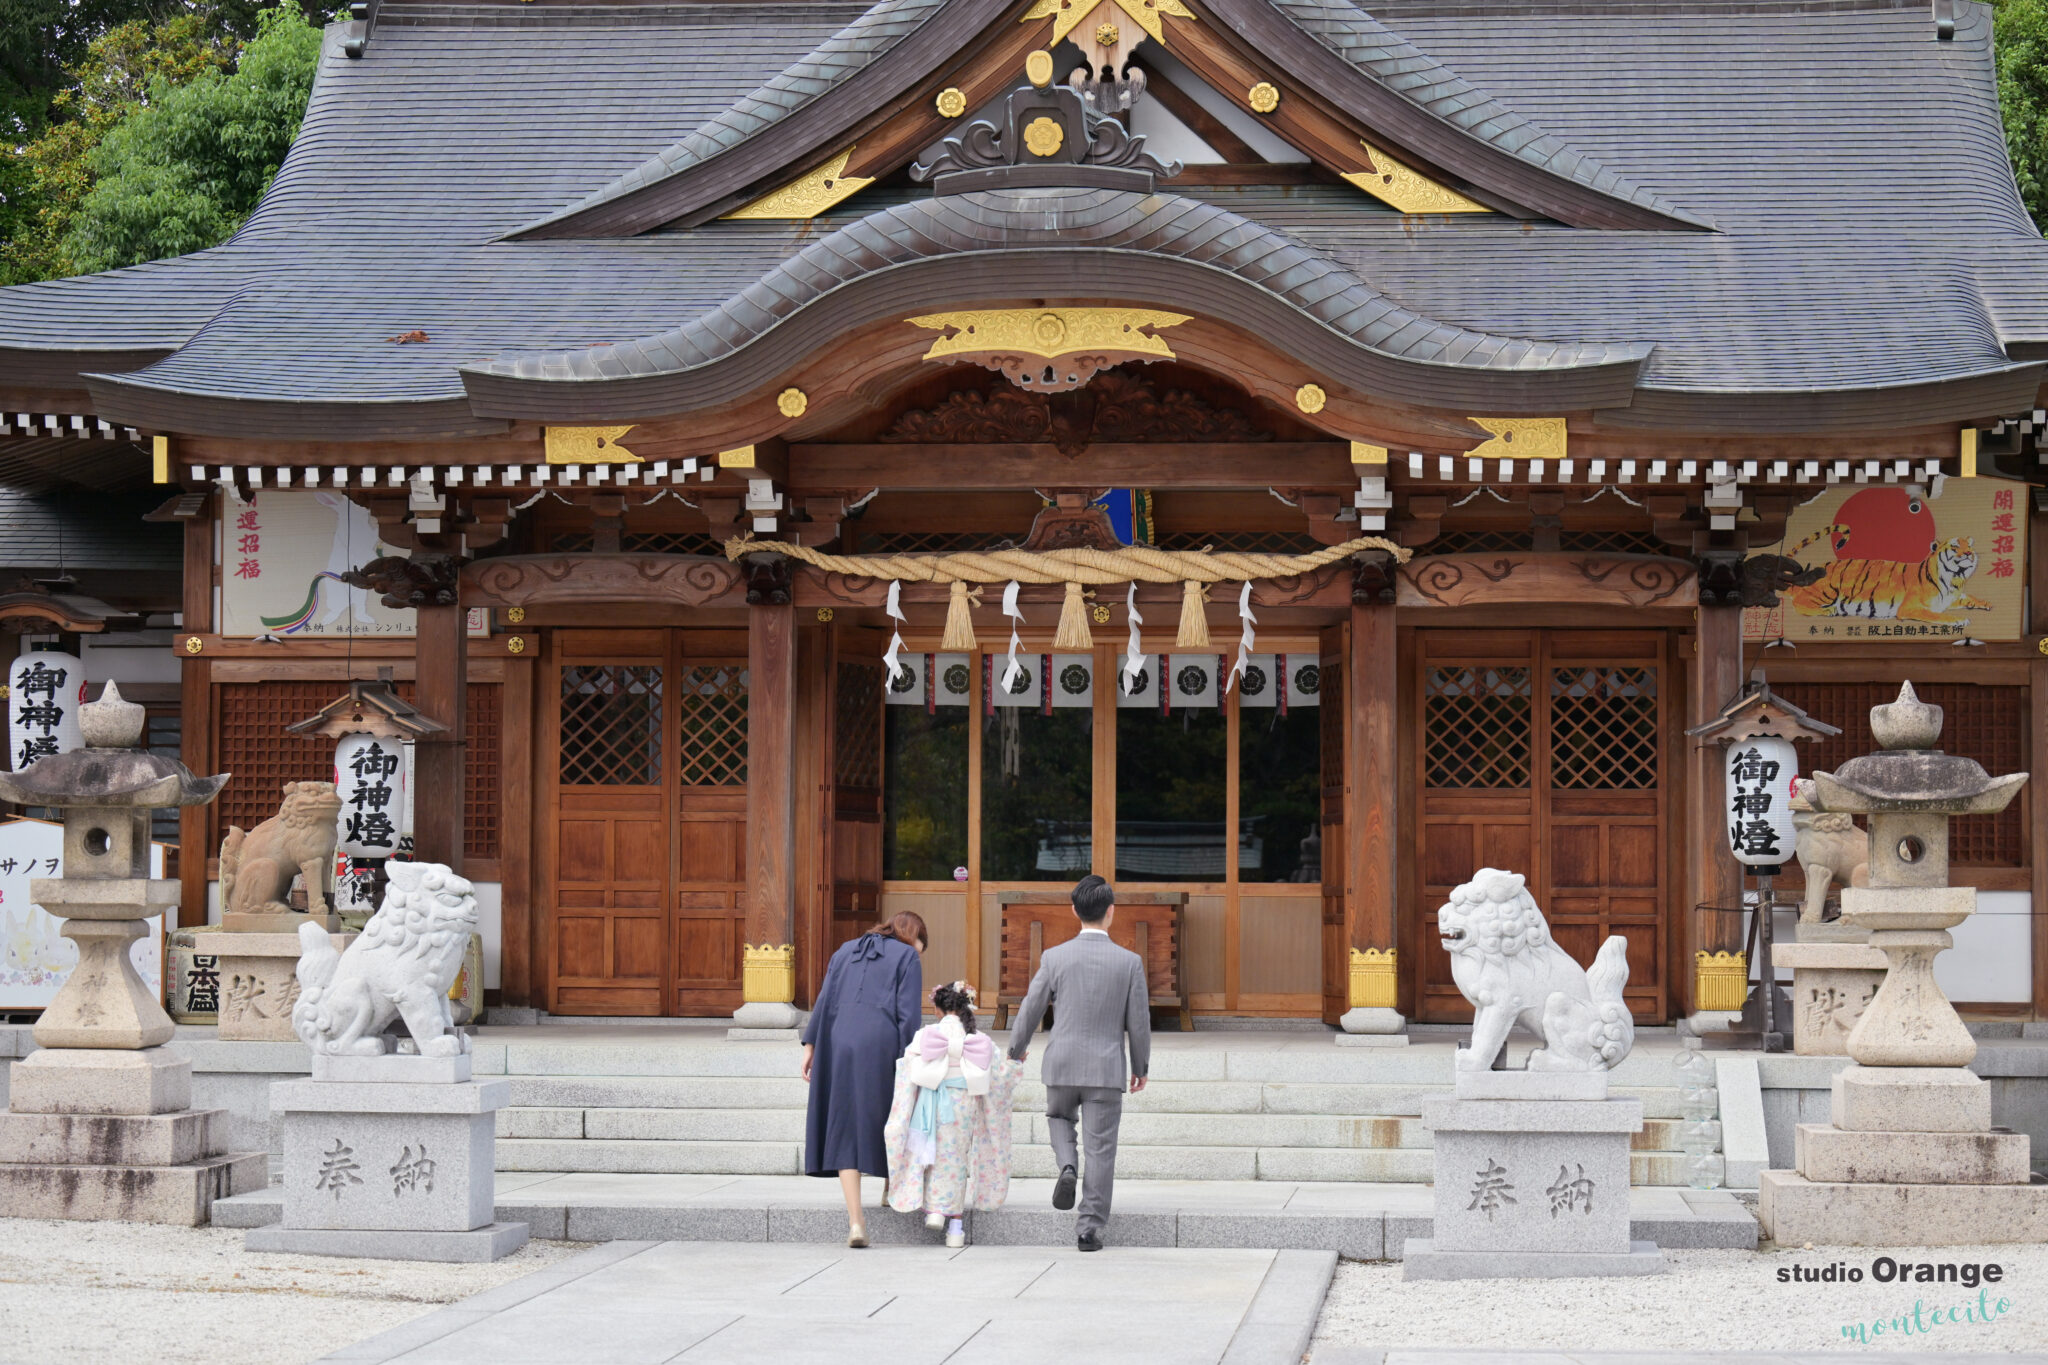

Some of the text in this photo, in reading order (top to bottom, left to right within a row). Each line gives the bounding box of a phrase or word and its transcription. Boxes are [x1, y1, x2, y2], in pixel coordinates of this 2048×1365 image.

[234, 492, 263, 580] 運招福
[1986, 489, 2018, 578] 開運招福
[303, 623, 324, 633] 奉納
[375, 622, 417, 632] シンリュ
[1868, 625, 1964, 636] 阪上自動車工業所
[345, 742, 398, 848] 御神燈
[1730, 747, 1781, 856] 御神燈
[0, 857, 59, 876] サノヲ
[186, 954, 220, 1012] 日本盛
[315, 1138, 437, 1200] 奉納
[1466, 1157, 1596, 1222] 奉納
